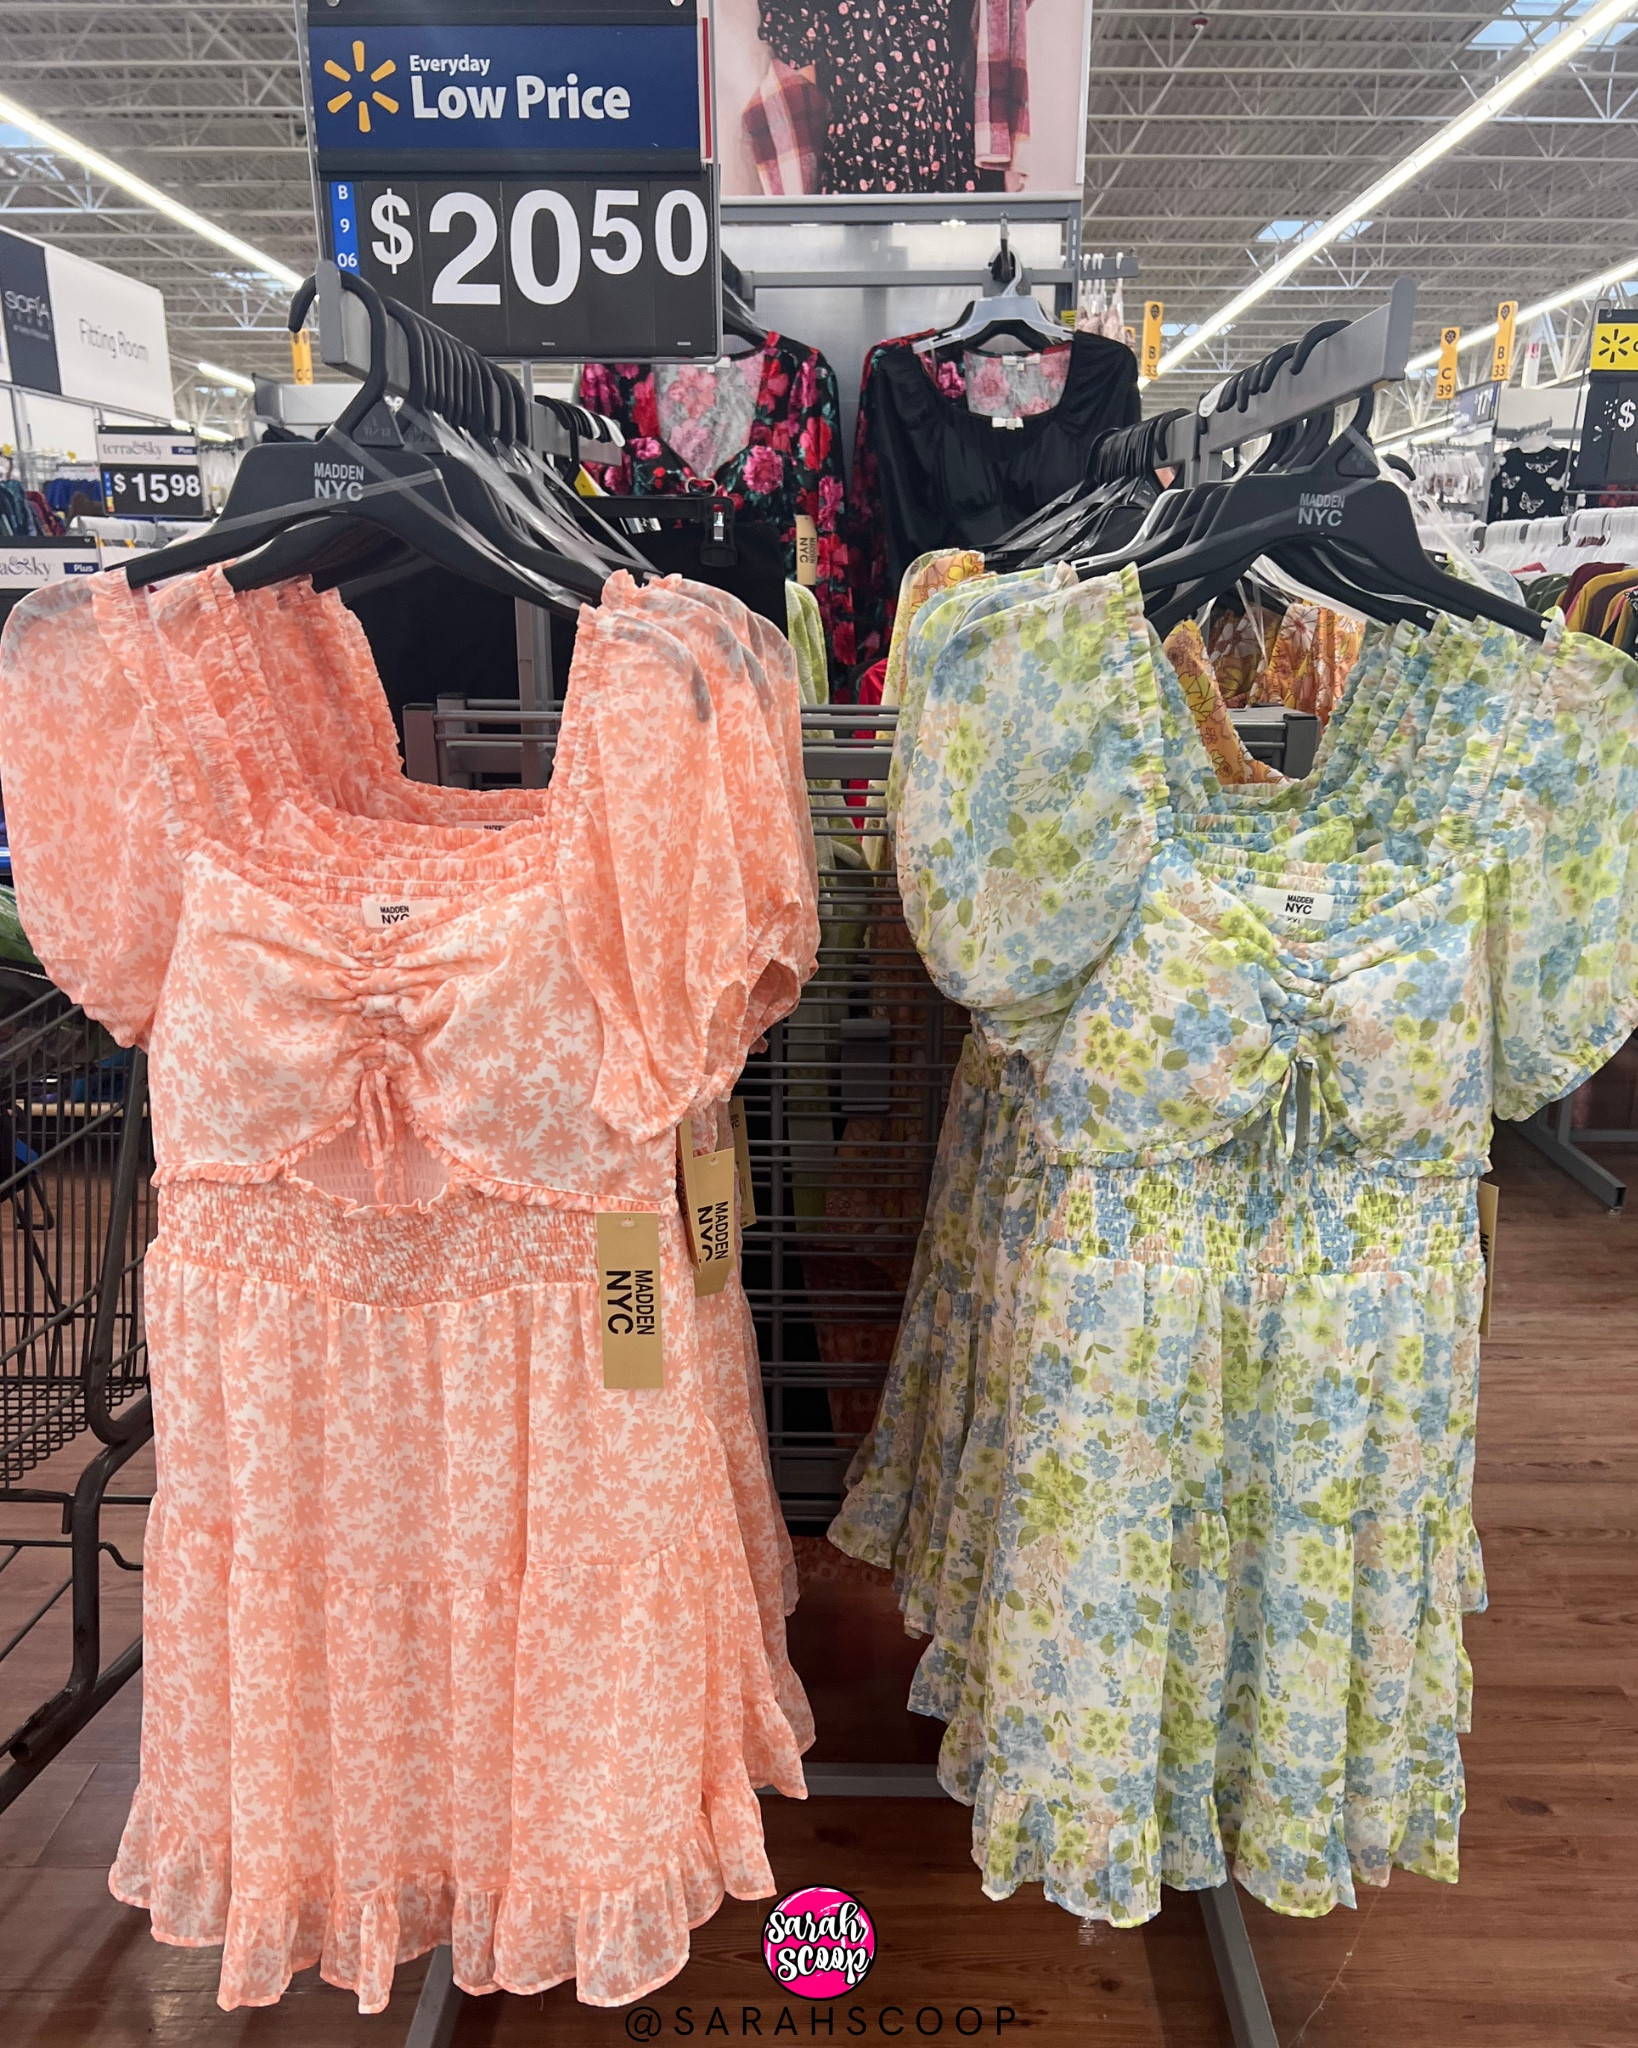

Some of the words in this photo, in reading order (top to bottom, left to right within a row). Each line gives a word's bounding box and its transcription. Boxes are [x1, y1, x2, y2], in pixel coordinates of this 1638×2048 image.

[409, 54, 491, 76] Everyday
[410, 75, 507, 119] Low
[516, 73, 631, 120] Price
[337, 185, 349, 200] B
[340, 218, 350, 233] 9
[337, 253, 357, 268] 06
[79, 318, 118, 359] Fitting
[118, 331, 149, 362] Room
[1497, 346, 1505, 359] B
[1441, 367, 1452, 380] C
[1493, 364, 1506, 377] 33
[1437, 384, 1452, 396] 39
[314, 462, 364, 480] MADDEN
[314, 479, 363, 501] NYC
[1300, 493, 1346, 508] MADDEN
[1298, 508, 1343, 527] NYC
[799, 537, 809, 563] NYC
[73, 563, 94, 572] Plus
[1287, 895, 1314, 904] MADDEN
[379, 905, 410, 914] MADDEN
[1285, 903, 1312, 914] NYC
[714, 1201, 728, 1260] MADDEN
[606, 1270, 634, 1335] NYC
[634, 1269, 655, 1335] MADDEN
